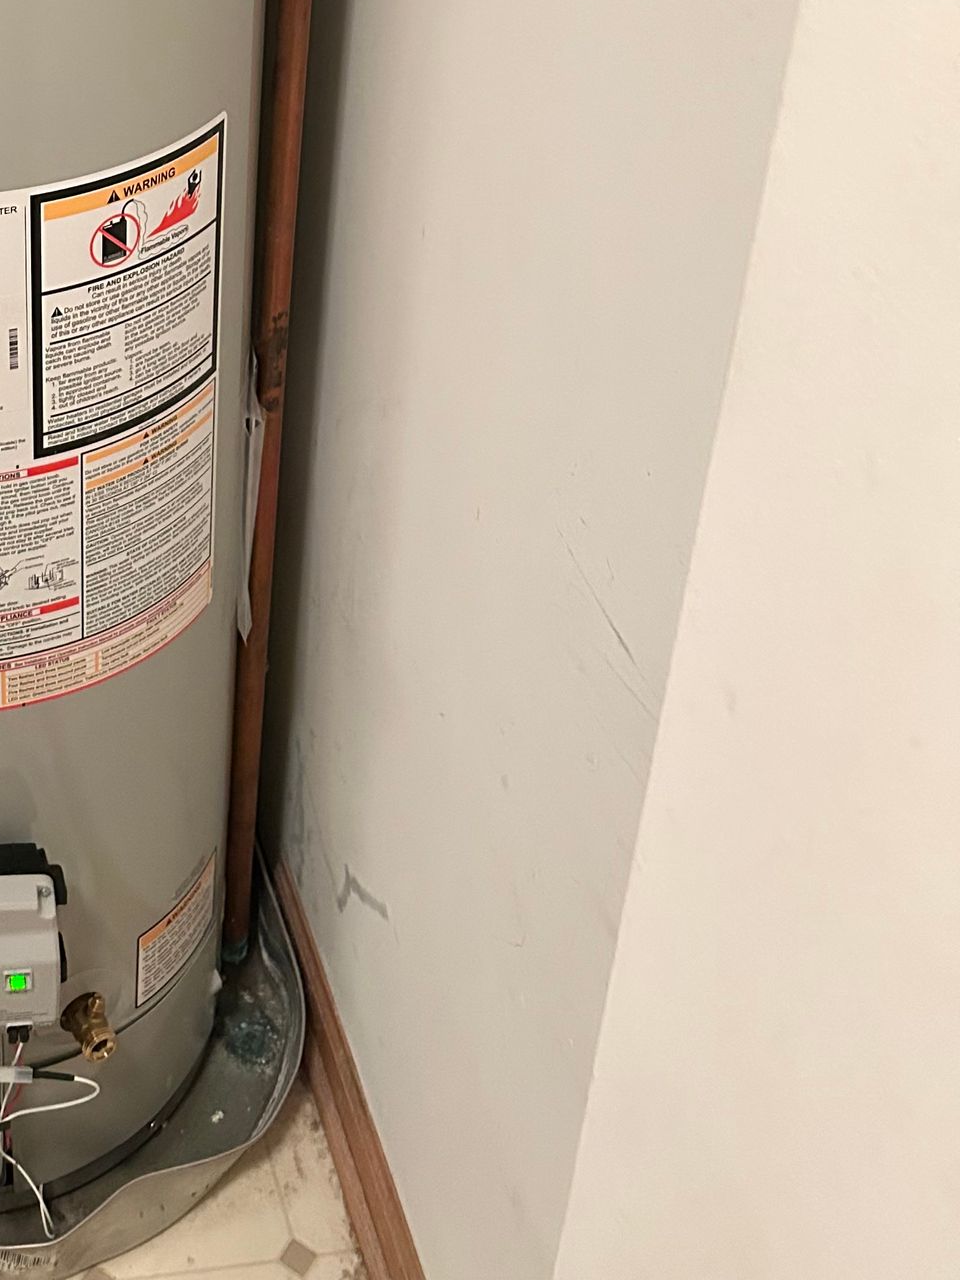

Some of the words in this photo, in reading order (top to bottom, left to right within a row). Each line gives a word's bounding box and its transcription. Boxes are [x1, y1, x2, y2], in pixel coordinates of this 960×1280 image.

[123, 167, 176, 197] WARNING
[88, 283, 104, 293] FIRE
[106, 277, 121, 287] AND
[123, 261, 160, 282] EXPLOSION
[161, 247, 184, 265] HAZARD
